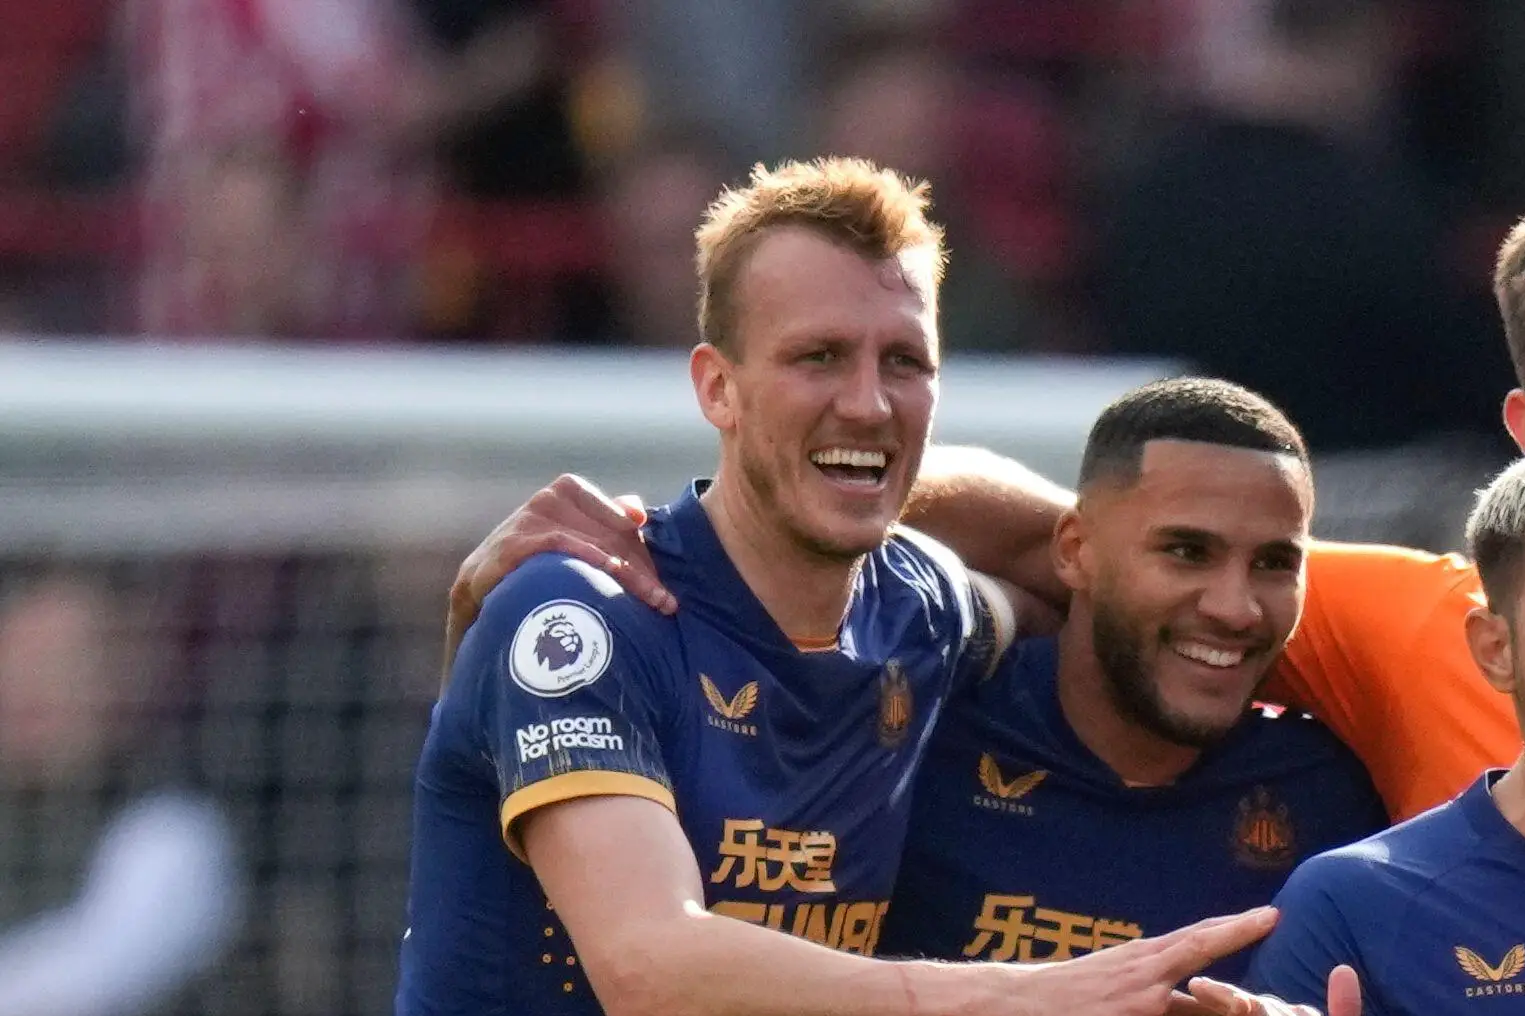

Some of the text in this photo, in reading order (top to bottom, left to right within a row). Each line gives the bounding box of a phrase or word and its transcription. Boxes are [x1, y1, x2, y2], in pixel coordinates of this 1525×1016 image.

[516, 717, 612, 745] No room
[519, 732, 624, 762] for racism
